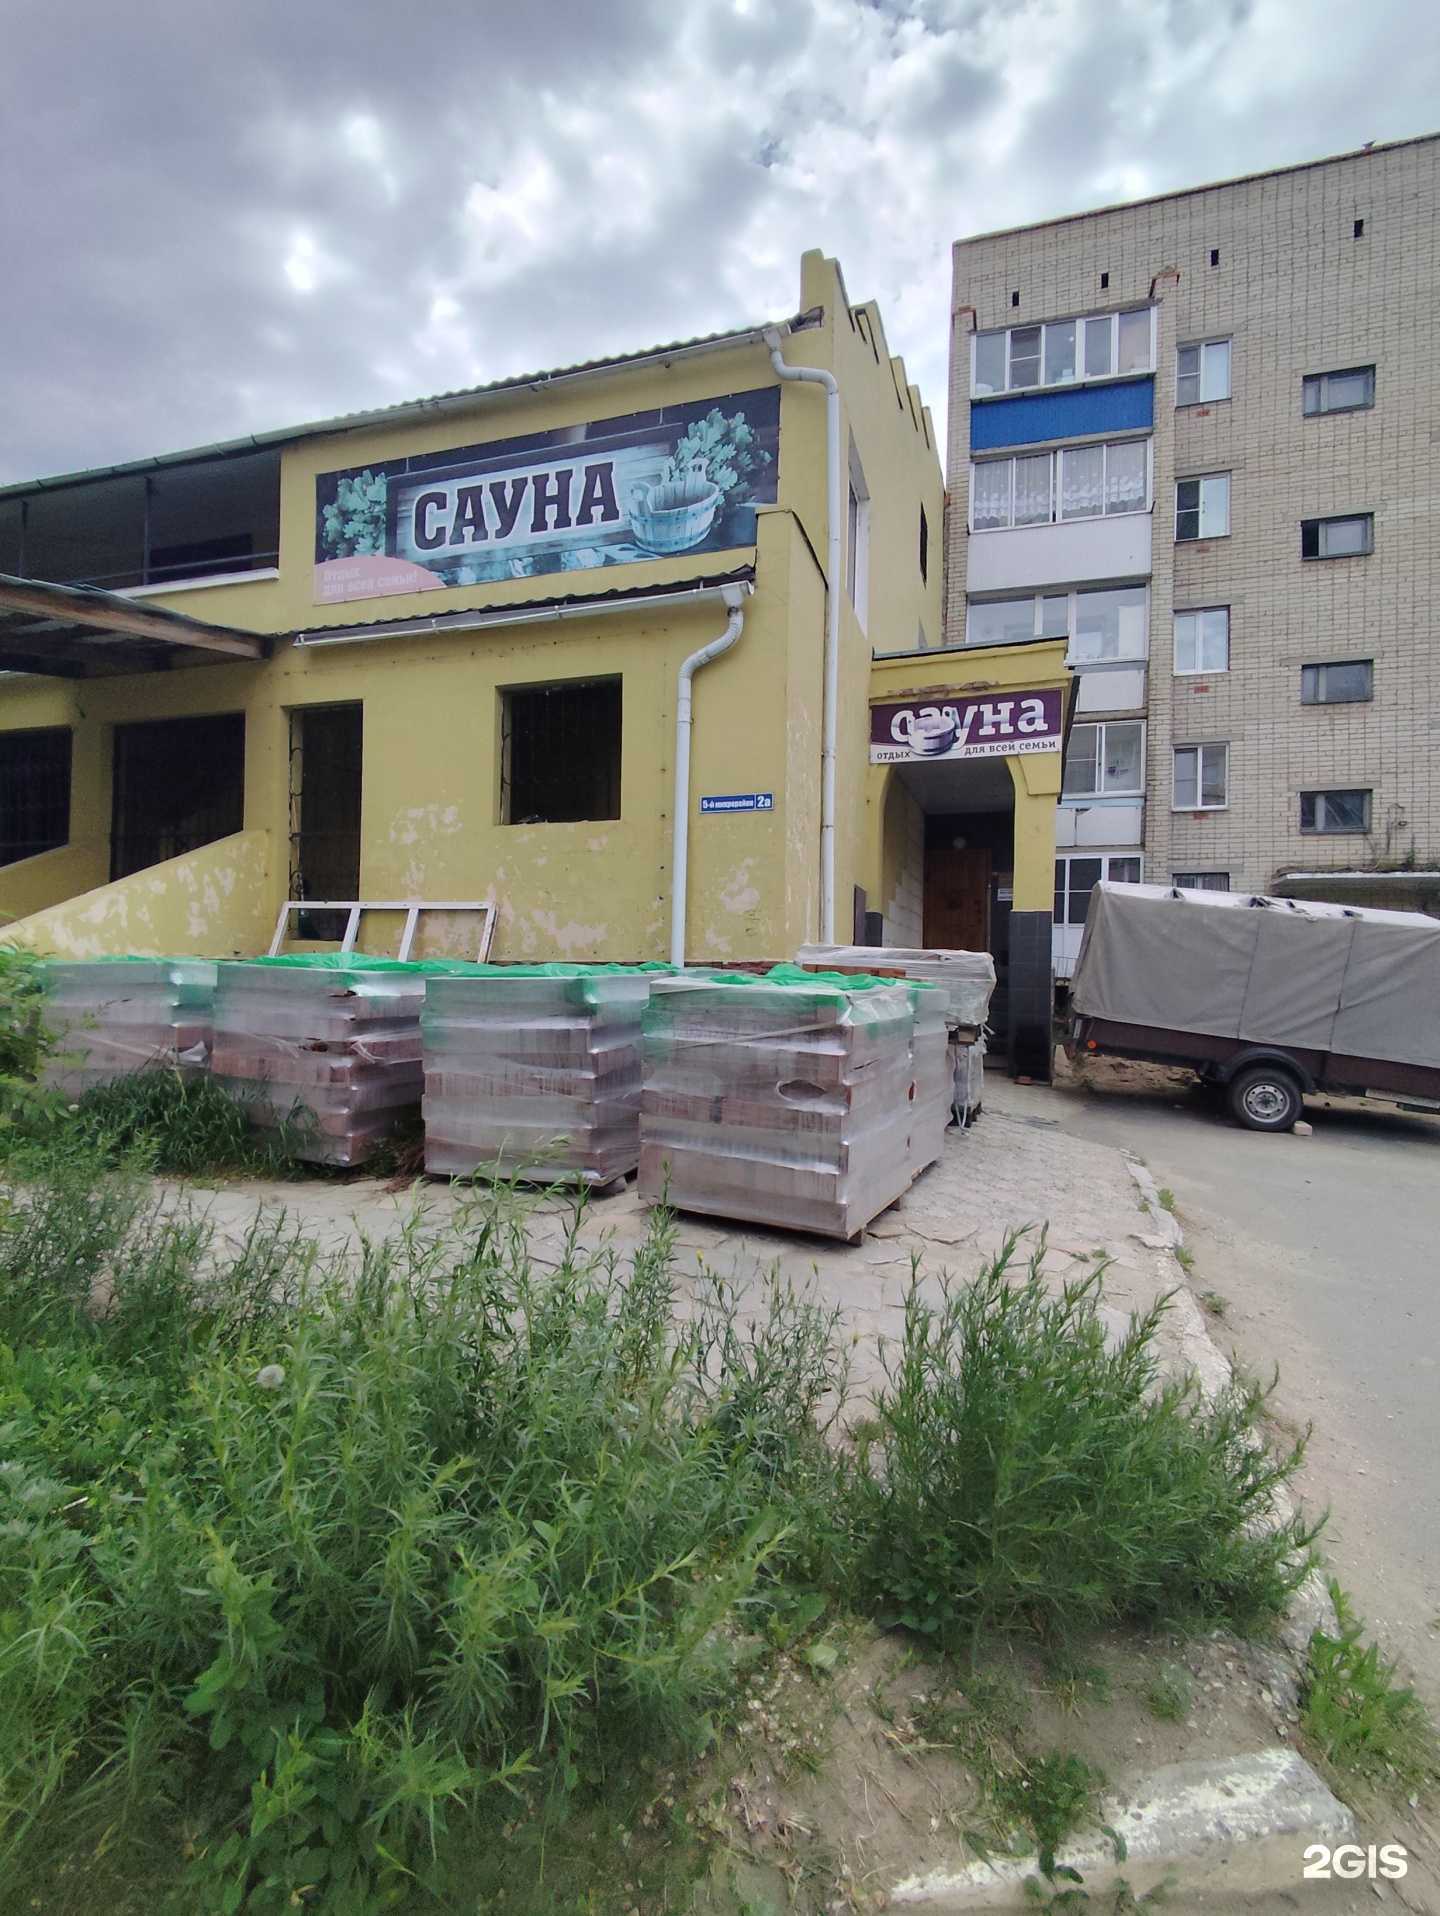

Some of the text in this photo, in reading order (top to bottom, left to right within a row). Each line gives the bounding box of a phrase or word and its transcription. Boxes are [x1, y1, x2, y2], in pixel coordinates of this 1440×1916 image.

[414, 461, 621, 551] САУНА
[876, 740, 1057, 761] отдых для всей семьи
